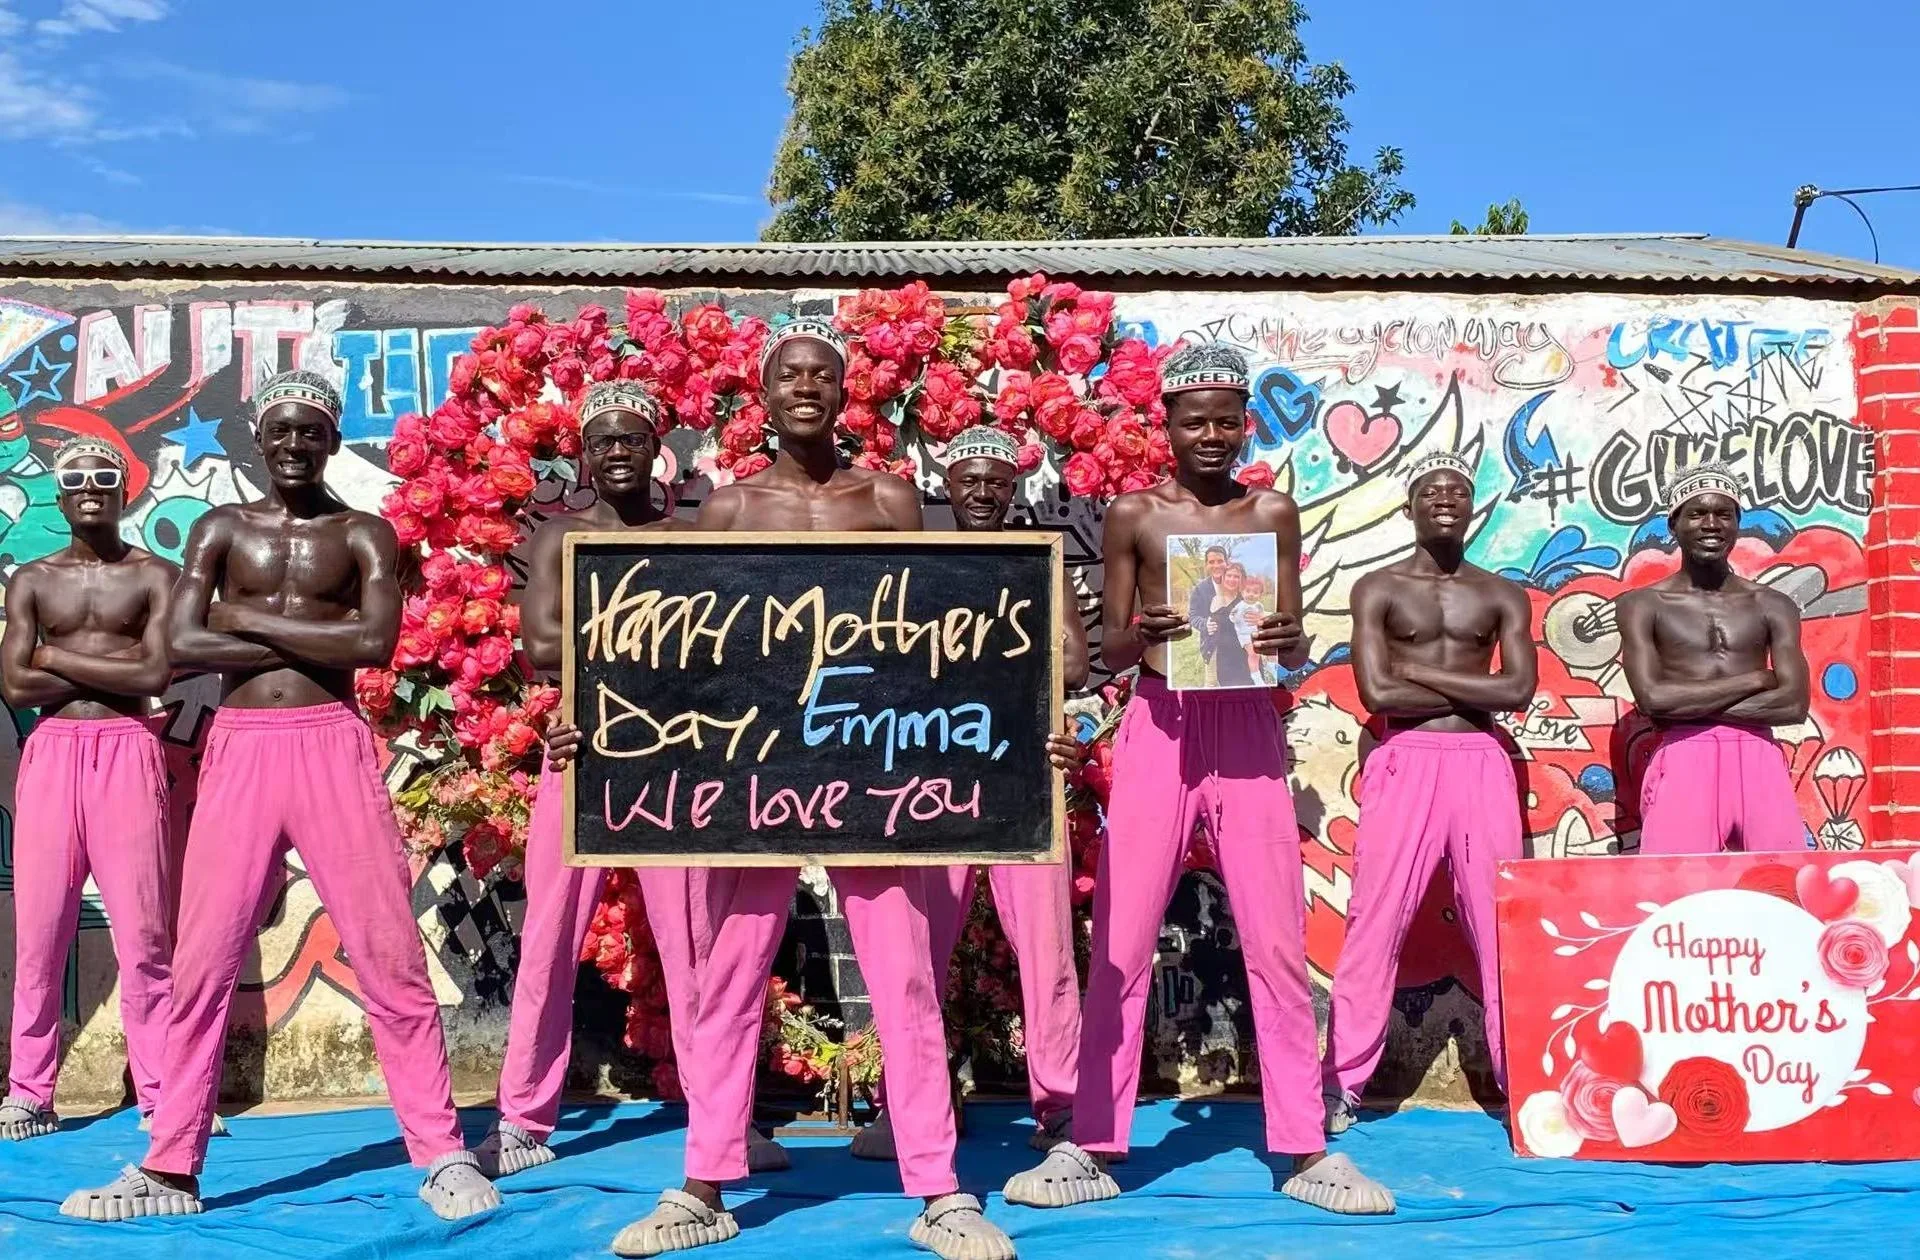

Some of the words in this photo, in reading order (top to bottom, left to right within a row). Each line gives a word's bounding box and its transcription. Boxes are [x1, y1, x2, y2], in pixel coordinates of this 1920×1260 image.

[580, 558, 750, 669] Happy
[761, 566, 1032, 706] Mother's
[591, 680, 780, 763] Day,
[802, 665, 1011, 771] Emma,
[1512, 700, 1578, 745] Love
[604, 769, 725, 832] We
[750, 774, 850, 831] love
[1652, 921, 1766, 977] Happy
[1642, 979, 1847, 1034] Mother's
[1742, 1043, 1821, 1105] Day
